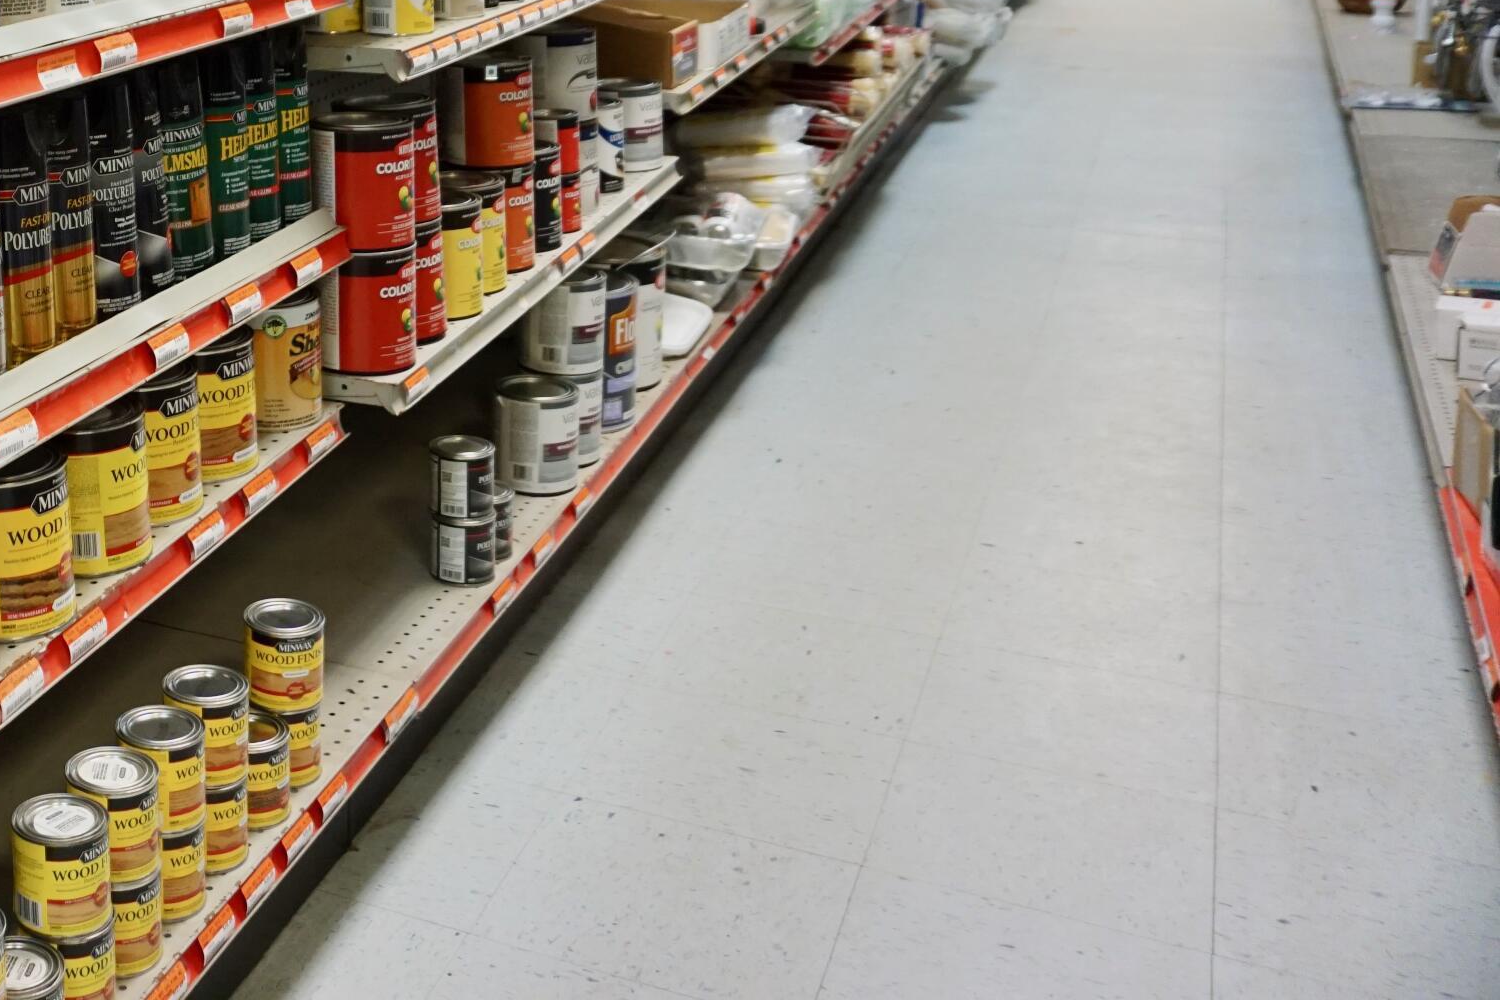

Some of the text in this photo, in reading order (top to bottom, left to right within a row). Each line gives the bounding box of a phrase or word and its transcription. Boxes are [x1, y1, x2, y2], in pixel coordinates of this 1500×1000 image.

[198, 384, 246, 405] WOOD
[7, 517, 63, 546] WOOD
[278, 640, 313, 652] MINWAX
[255, 650, 295, 665] WOOD
[209, 720, 245, 738] WOOD
[114, 808, 154, 831] WOOD
[52, 863, 100, 882] WOOD
[65, 959, 107, 980] WOOD
